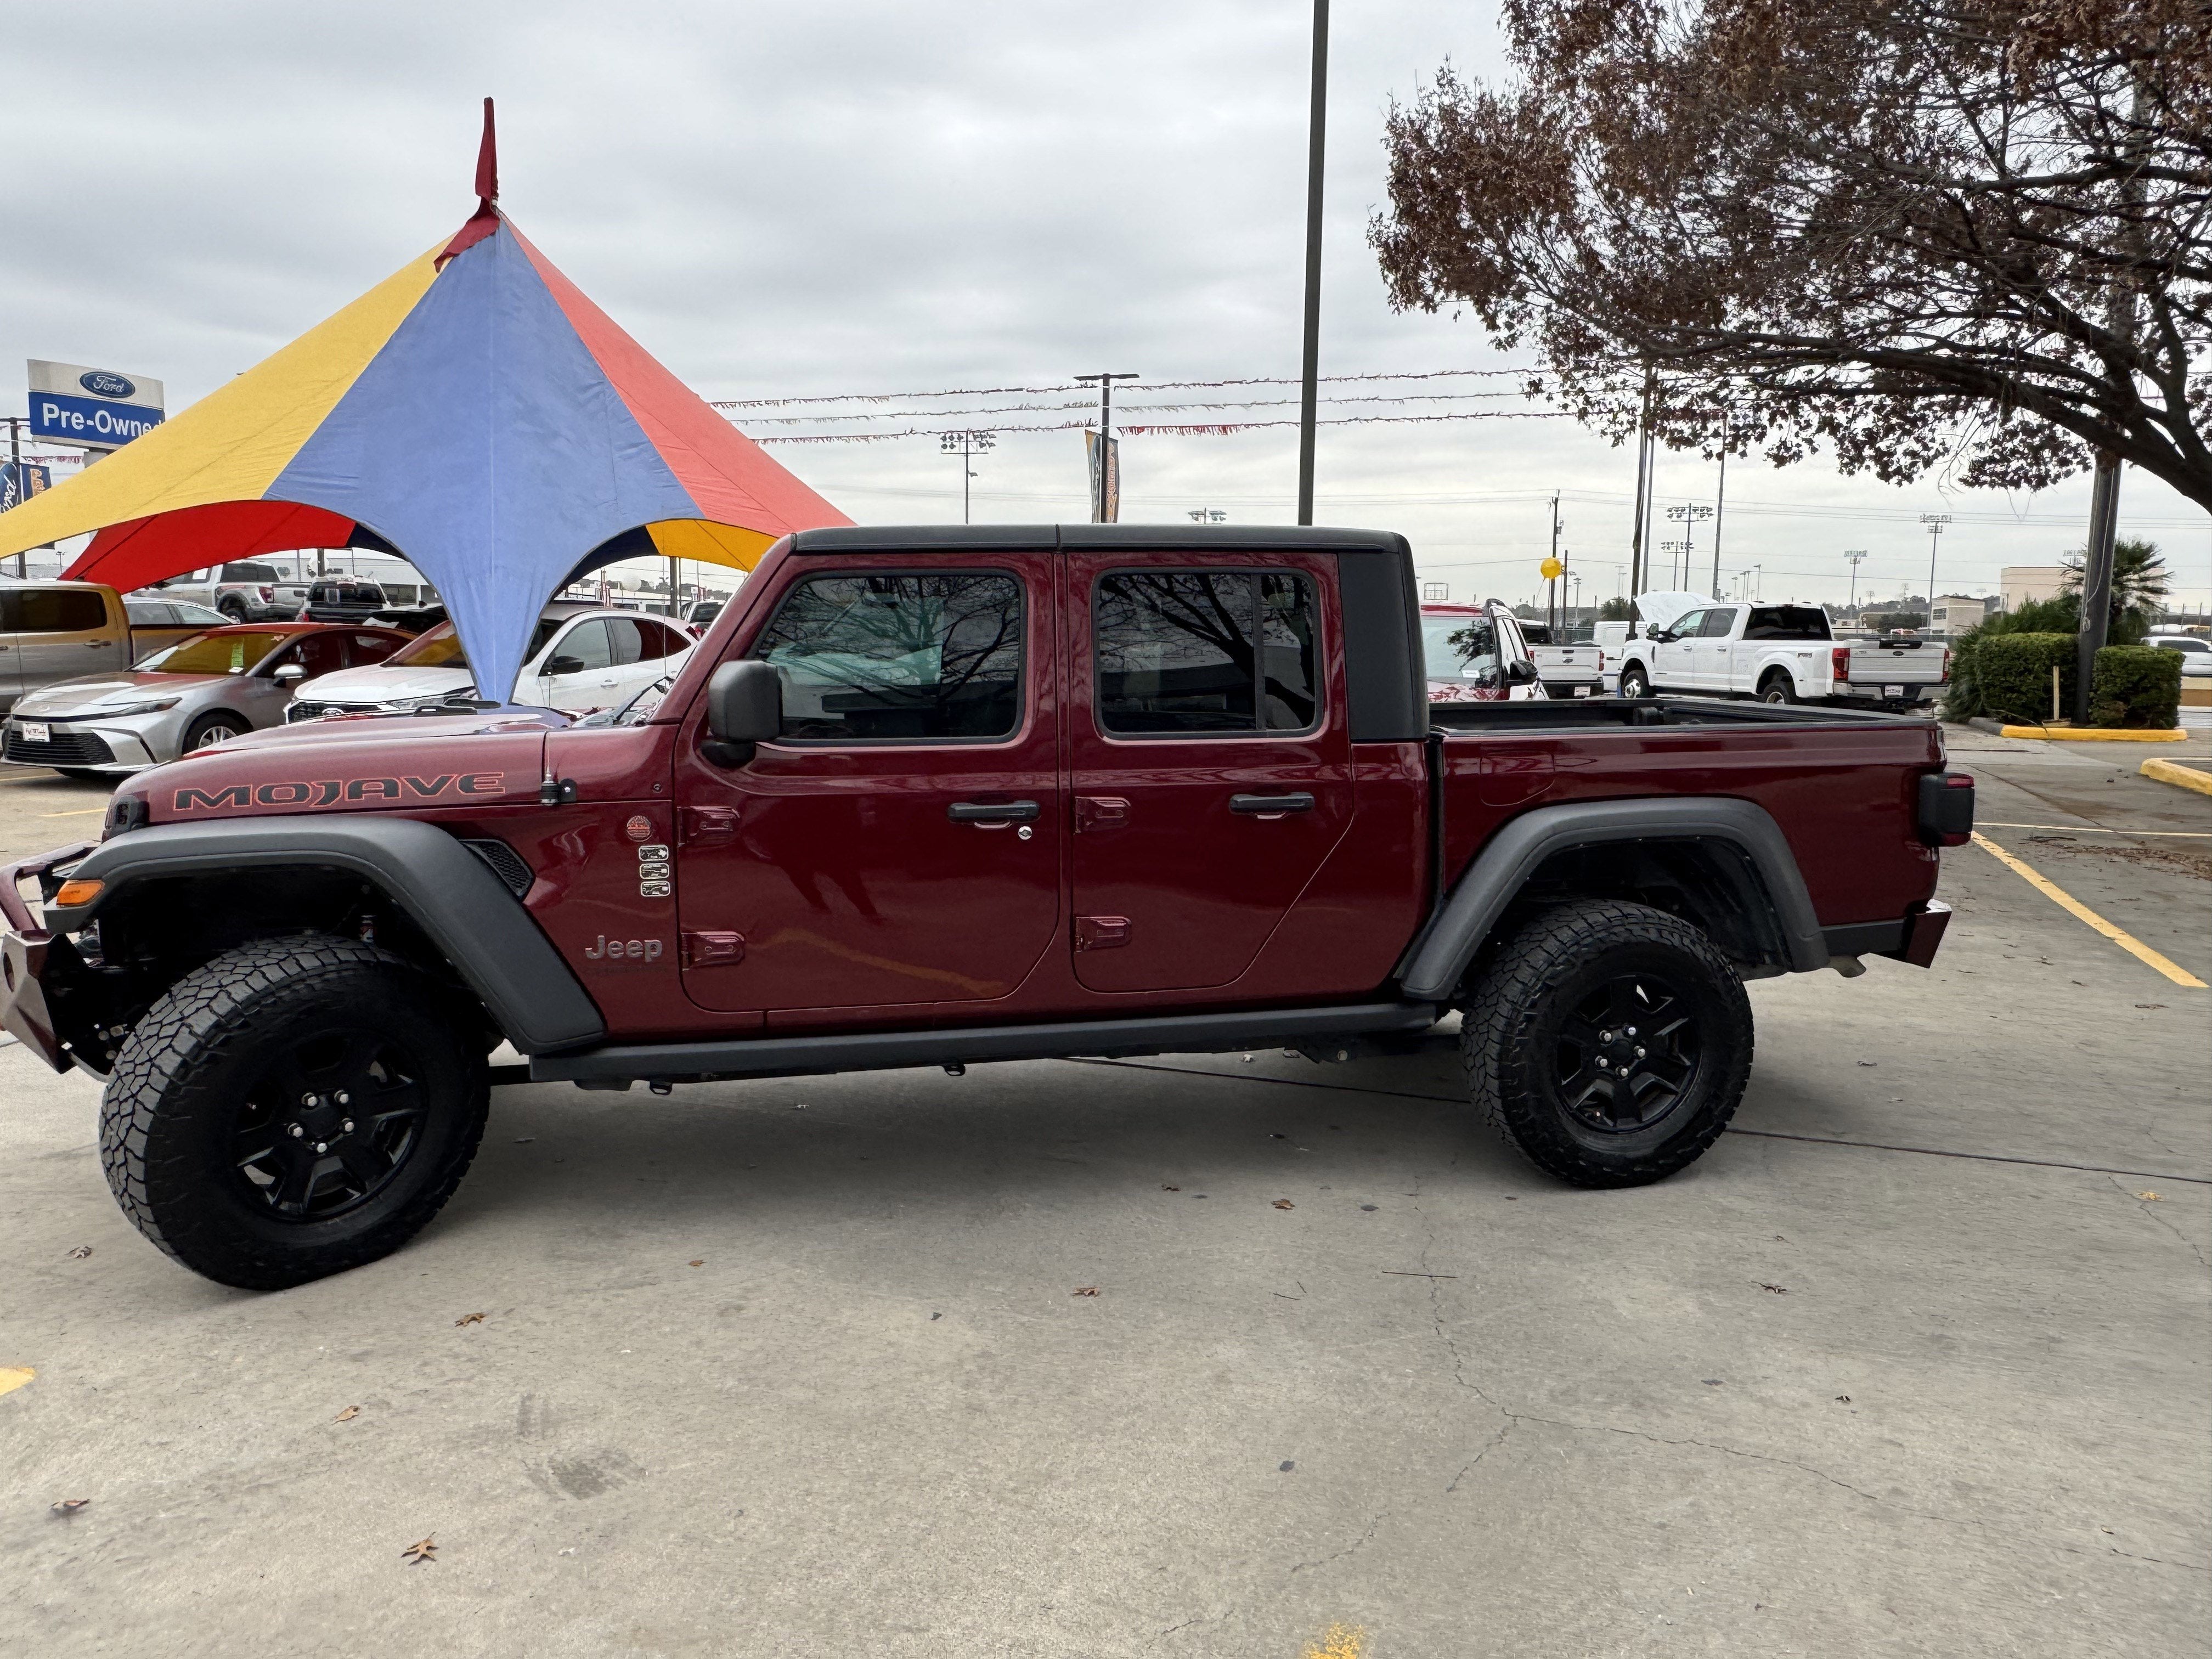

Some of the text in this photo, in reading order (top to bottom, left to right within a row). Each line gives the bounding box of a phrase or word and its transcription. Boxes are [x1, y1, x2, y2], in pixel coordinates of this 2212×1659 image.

[93, 376, 125, 393] Ford
[173, 771, 506, 810] MOJAVE
[585, 935, 663, 962] Jeep
